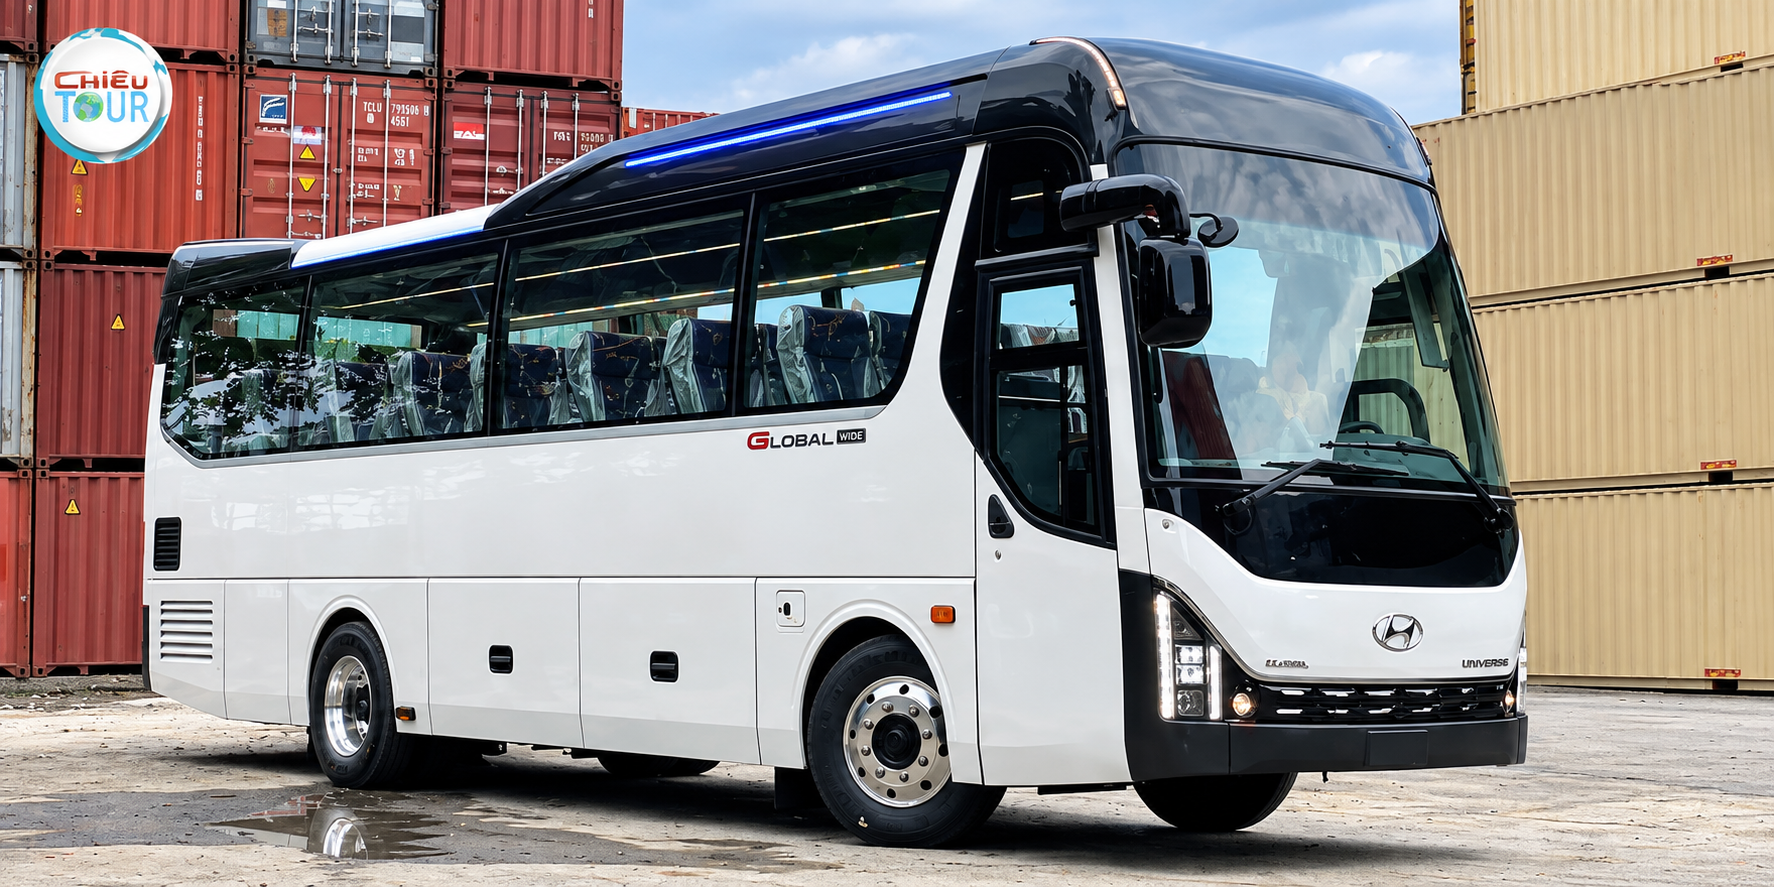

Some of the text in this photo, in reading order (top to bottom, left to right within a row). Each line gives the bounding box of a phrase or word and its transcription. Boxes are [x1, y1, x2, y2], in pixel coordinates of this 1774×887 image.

[363, 101, 383, 113] TCLU
[746, 431, 864, 451] GLOBAL WIDE
[1461, 658, 1509, 669] UNIVERSE
